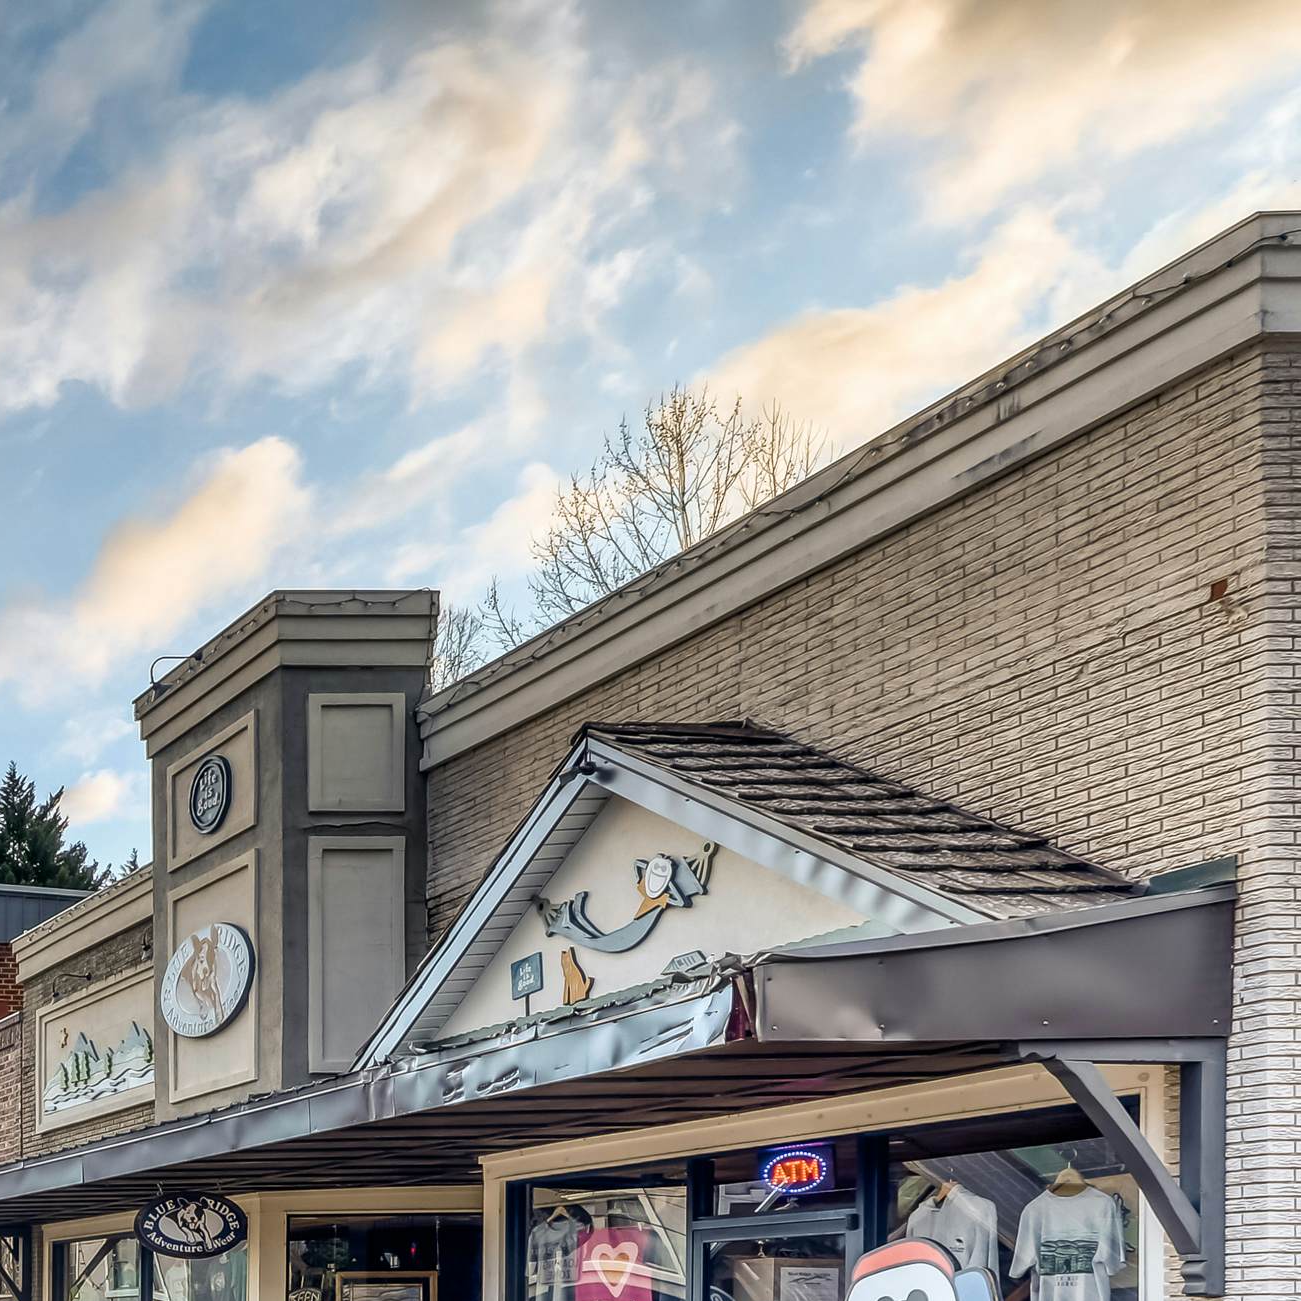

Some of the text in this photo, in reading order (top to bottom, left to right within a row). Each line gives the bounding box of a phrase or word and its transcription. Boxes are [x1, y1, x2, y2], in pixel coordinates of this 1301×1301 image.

[200, 767, 218, 791] Life
[205, 787, 213, 799] is
[772, 1159, 819, 1185] ATM
[143, 1199, 240, 1231] BLUE RIDGE
[147, 1231, 236, 1253] Adventure Wear
